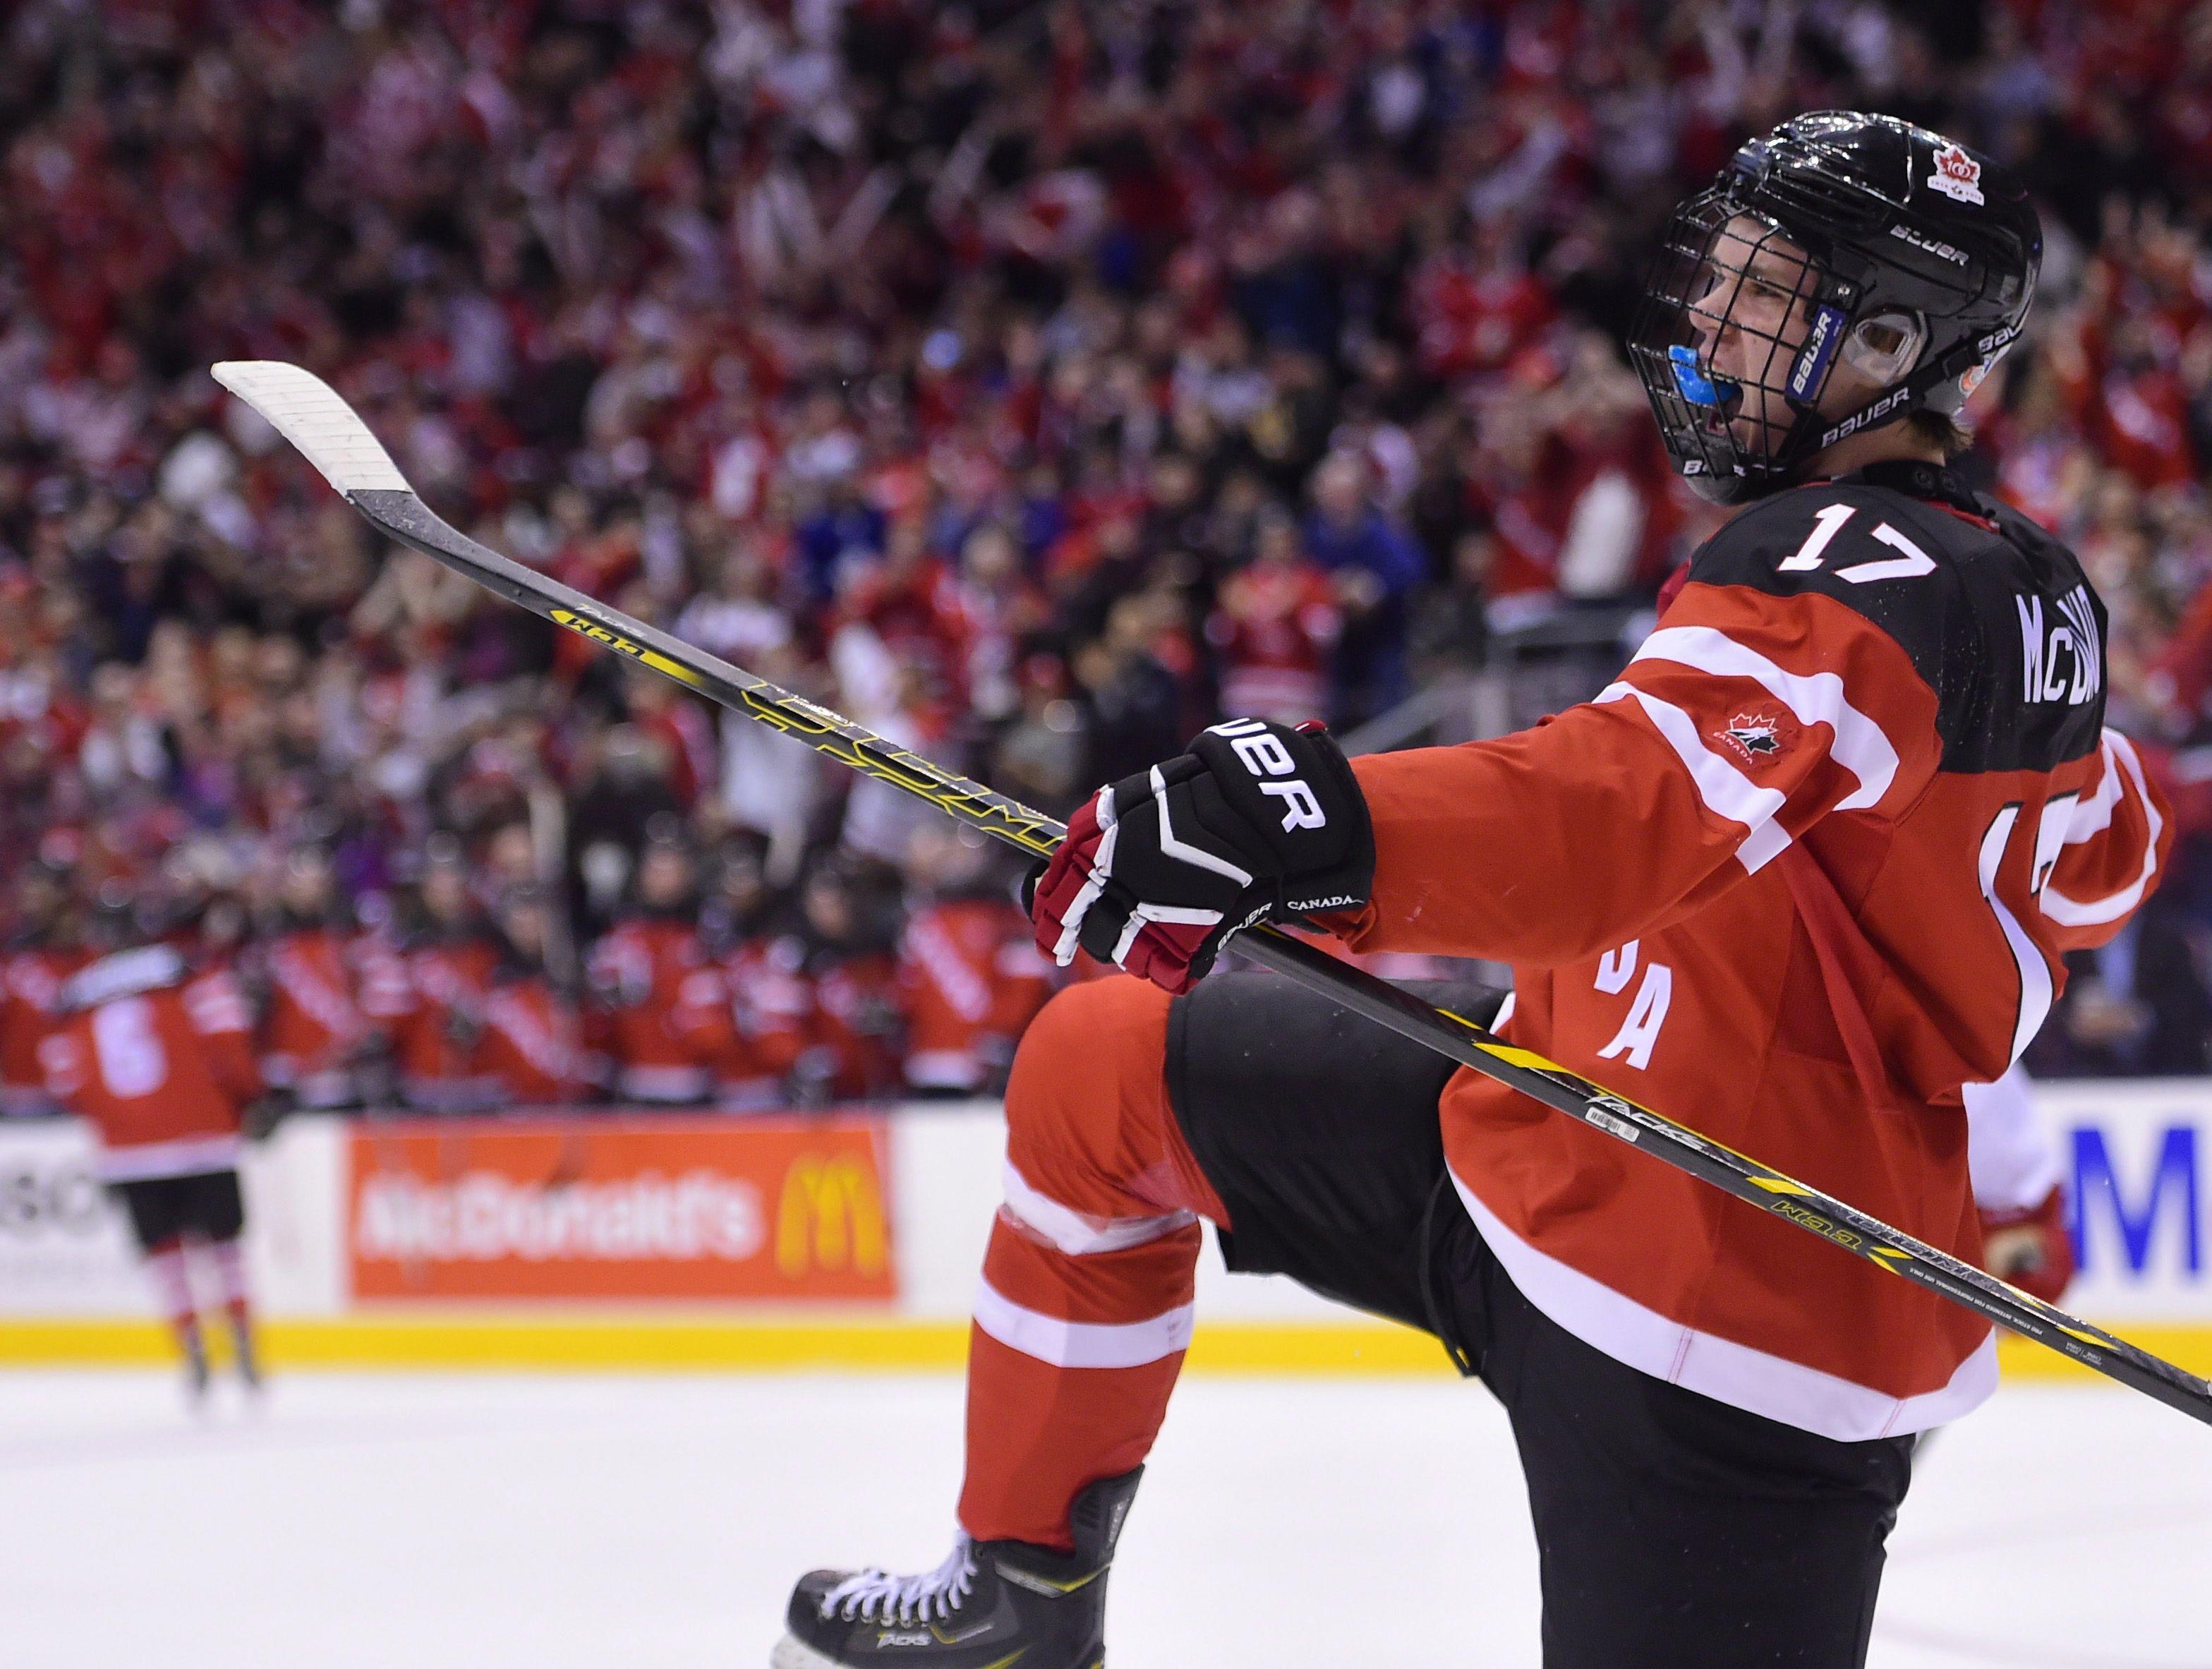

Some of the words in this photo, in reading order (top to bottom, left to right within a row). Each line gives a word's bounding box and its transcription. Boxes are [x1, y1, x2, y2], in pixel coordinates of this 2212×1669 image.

[1890, 224, 1969, 266] BAUER
[1792, 312, 1832, 395] BAUER
[1821, 387, 1910, 448] BAUER
[1776, 503, 1938, 584] 17
[564, 617, 645, 658] CCM
[1713, 731, 1753, 765] CANADA
[1287, 894, 1355, 911] CANADA
[1217, 902, 1272, 951] BAUER
[1585, 1087, 1708, 1150] TACKS
[358, 1170, 762, 1260] McDonald's
[1771, 1200, 1863, 1251] CCM
[1924, 1275, 1935, 1283] USE
[1974, 1297, 1986, 1306] FOR
[876, 1630, 932, 1649] TACKS
